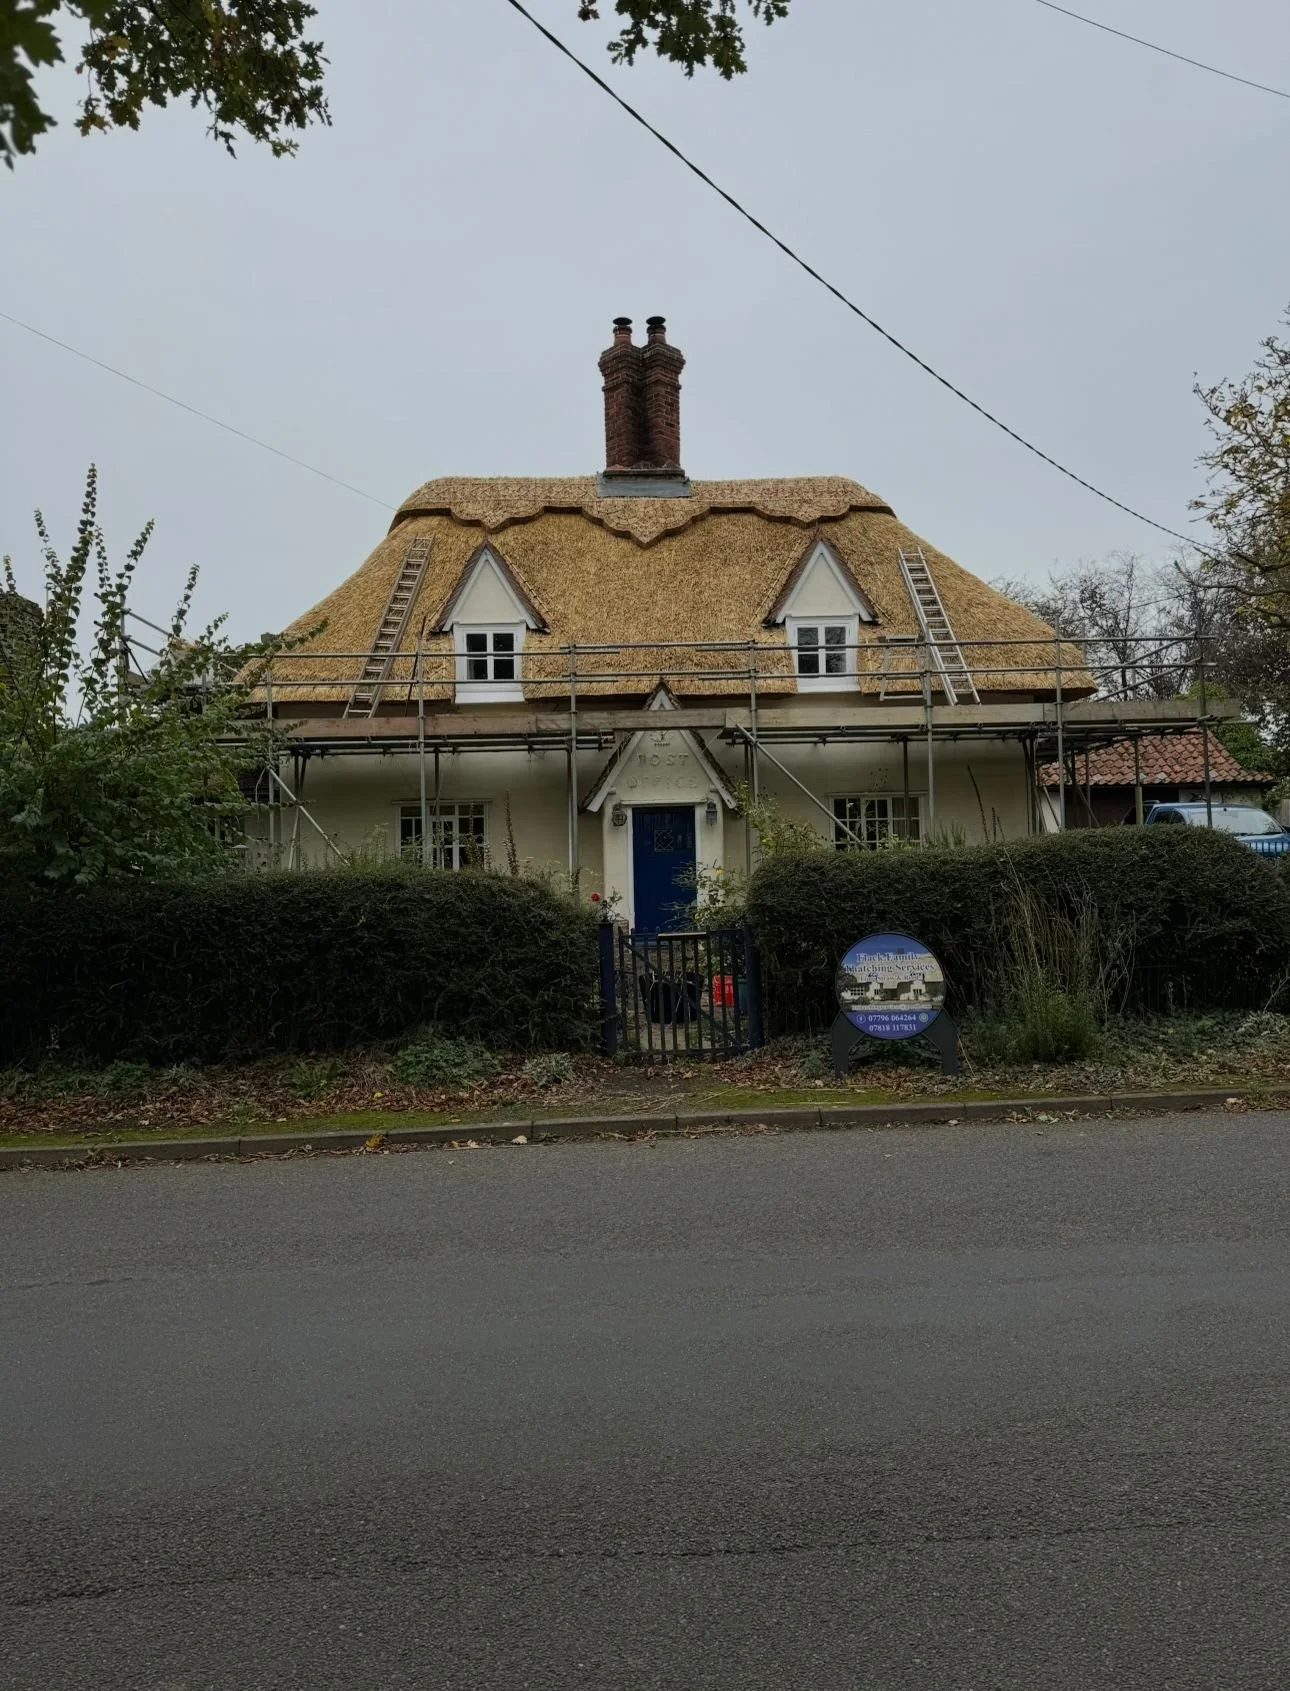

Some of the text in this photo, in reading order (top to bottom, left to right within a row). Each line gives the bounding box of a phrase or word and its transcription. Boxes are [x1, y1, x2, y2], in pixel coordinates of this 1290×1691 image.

[636, 751, 689, 767] POST
[626, 775, 697, 789] OFFICE
[885, 951, 920, 963] Family
[844, 963, 935, 973] Thatching Services
[868, 1014, 889, 1022] 07796
[869, 1023, 916, 1032] 07818 117831
